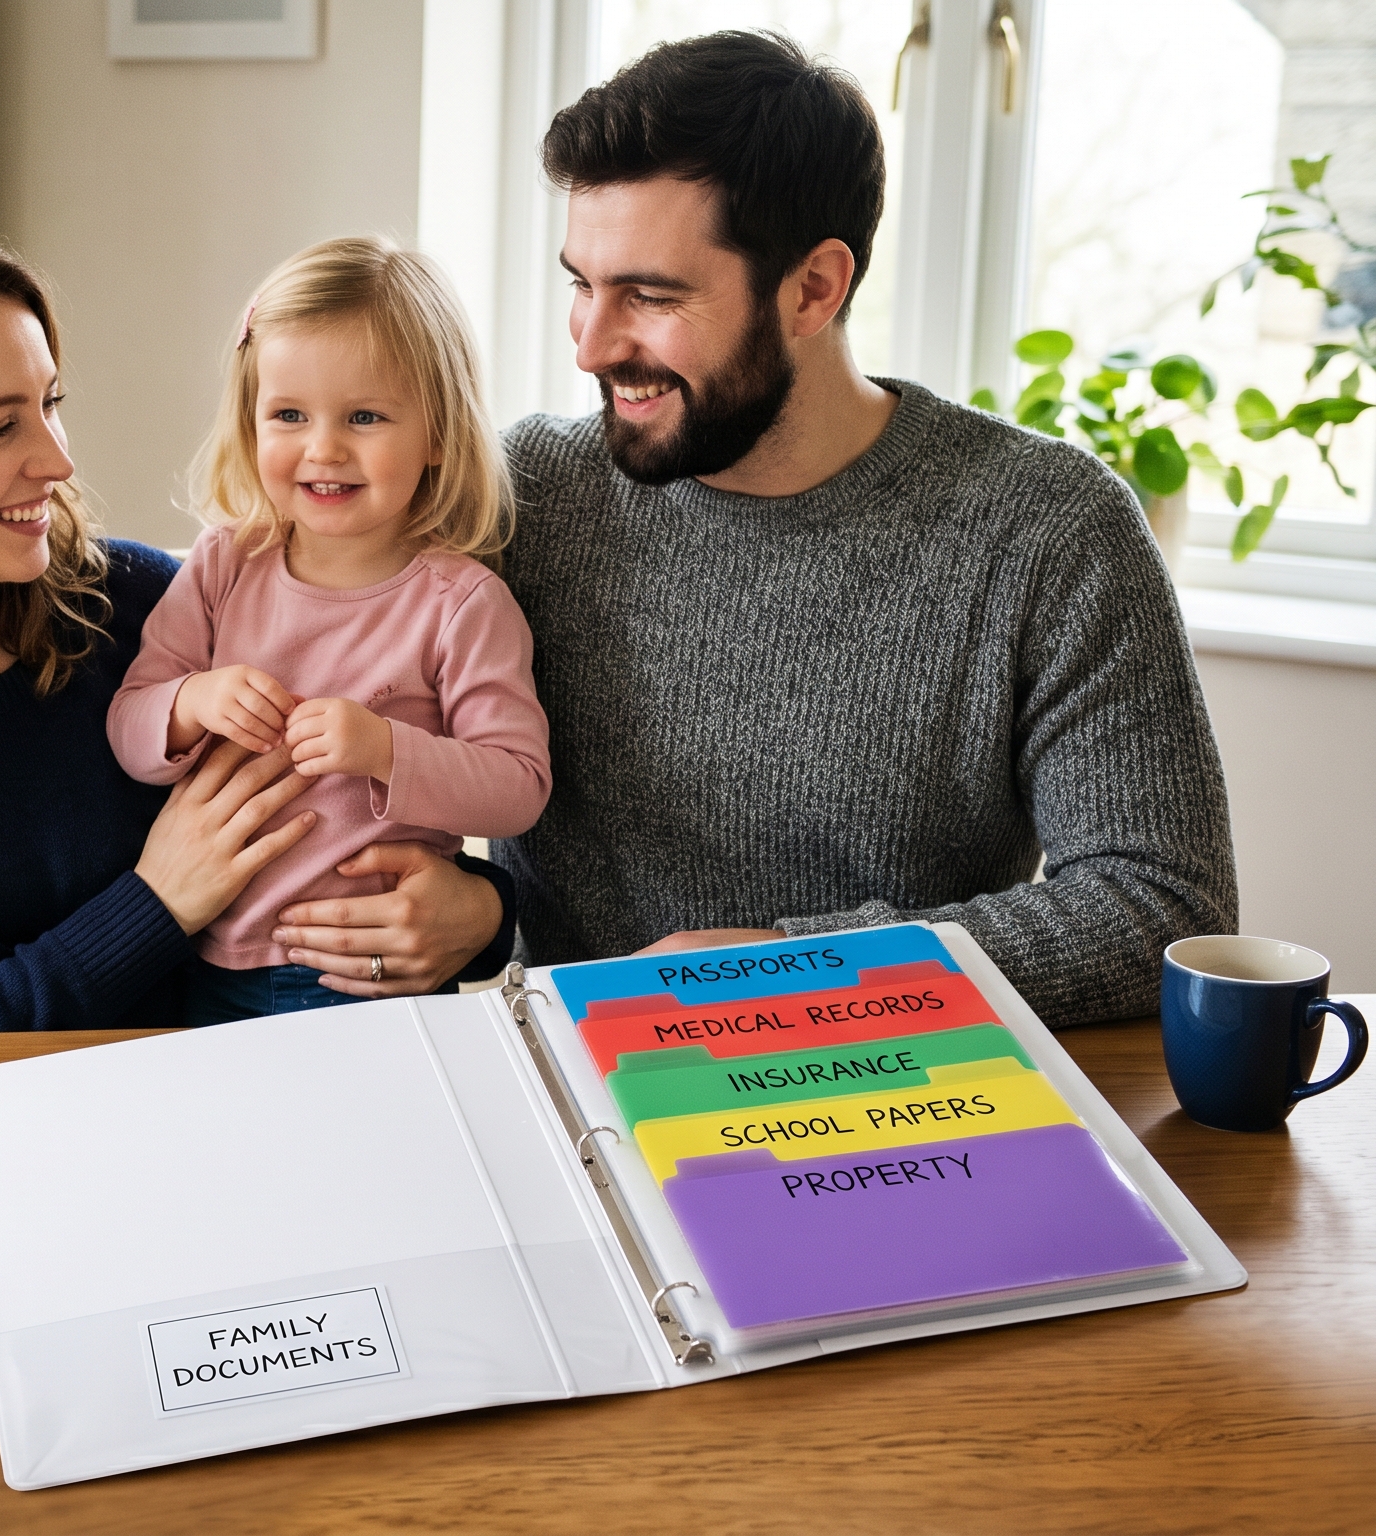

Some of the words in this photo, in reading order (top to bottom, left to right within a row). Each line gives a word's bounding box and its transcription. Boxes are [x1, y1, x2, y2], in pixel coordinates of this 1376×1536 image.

[657, 948, 844, 987] PASSPORTS
[653, 1012, 796, 1043] MEDICAL
[805, 991, 945, 1025] RECORDS
[727, 1051, 921, 1093] INSURANCE
[720, 1115, 855, 1147] SCHOOL
[865, 1094, 996, 1129] PAPERS
[780, 1152, 973, 1199] PROPERTY
[208, 1313, 327, 1350] FAMILY
[172, 1337, 377, 1387] DOCUMENTS
